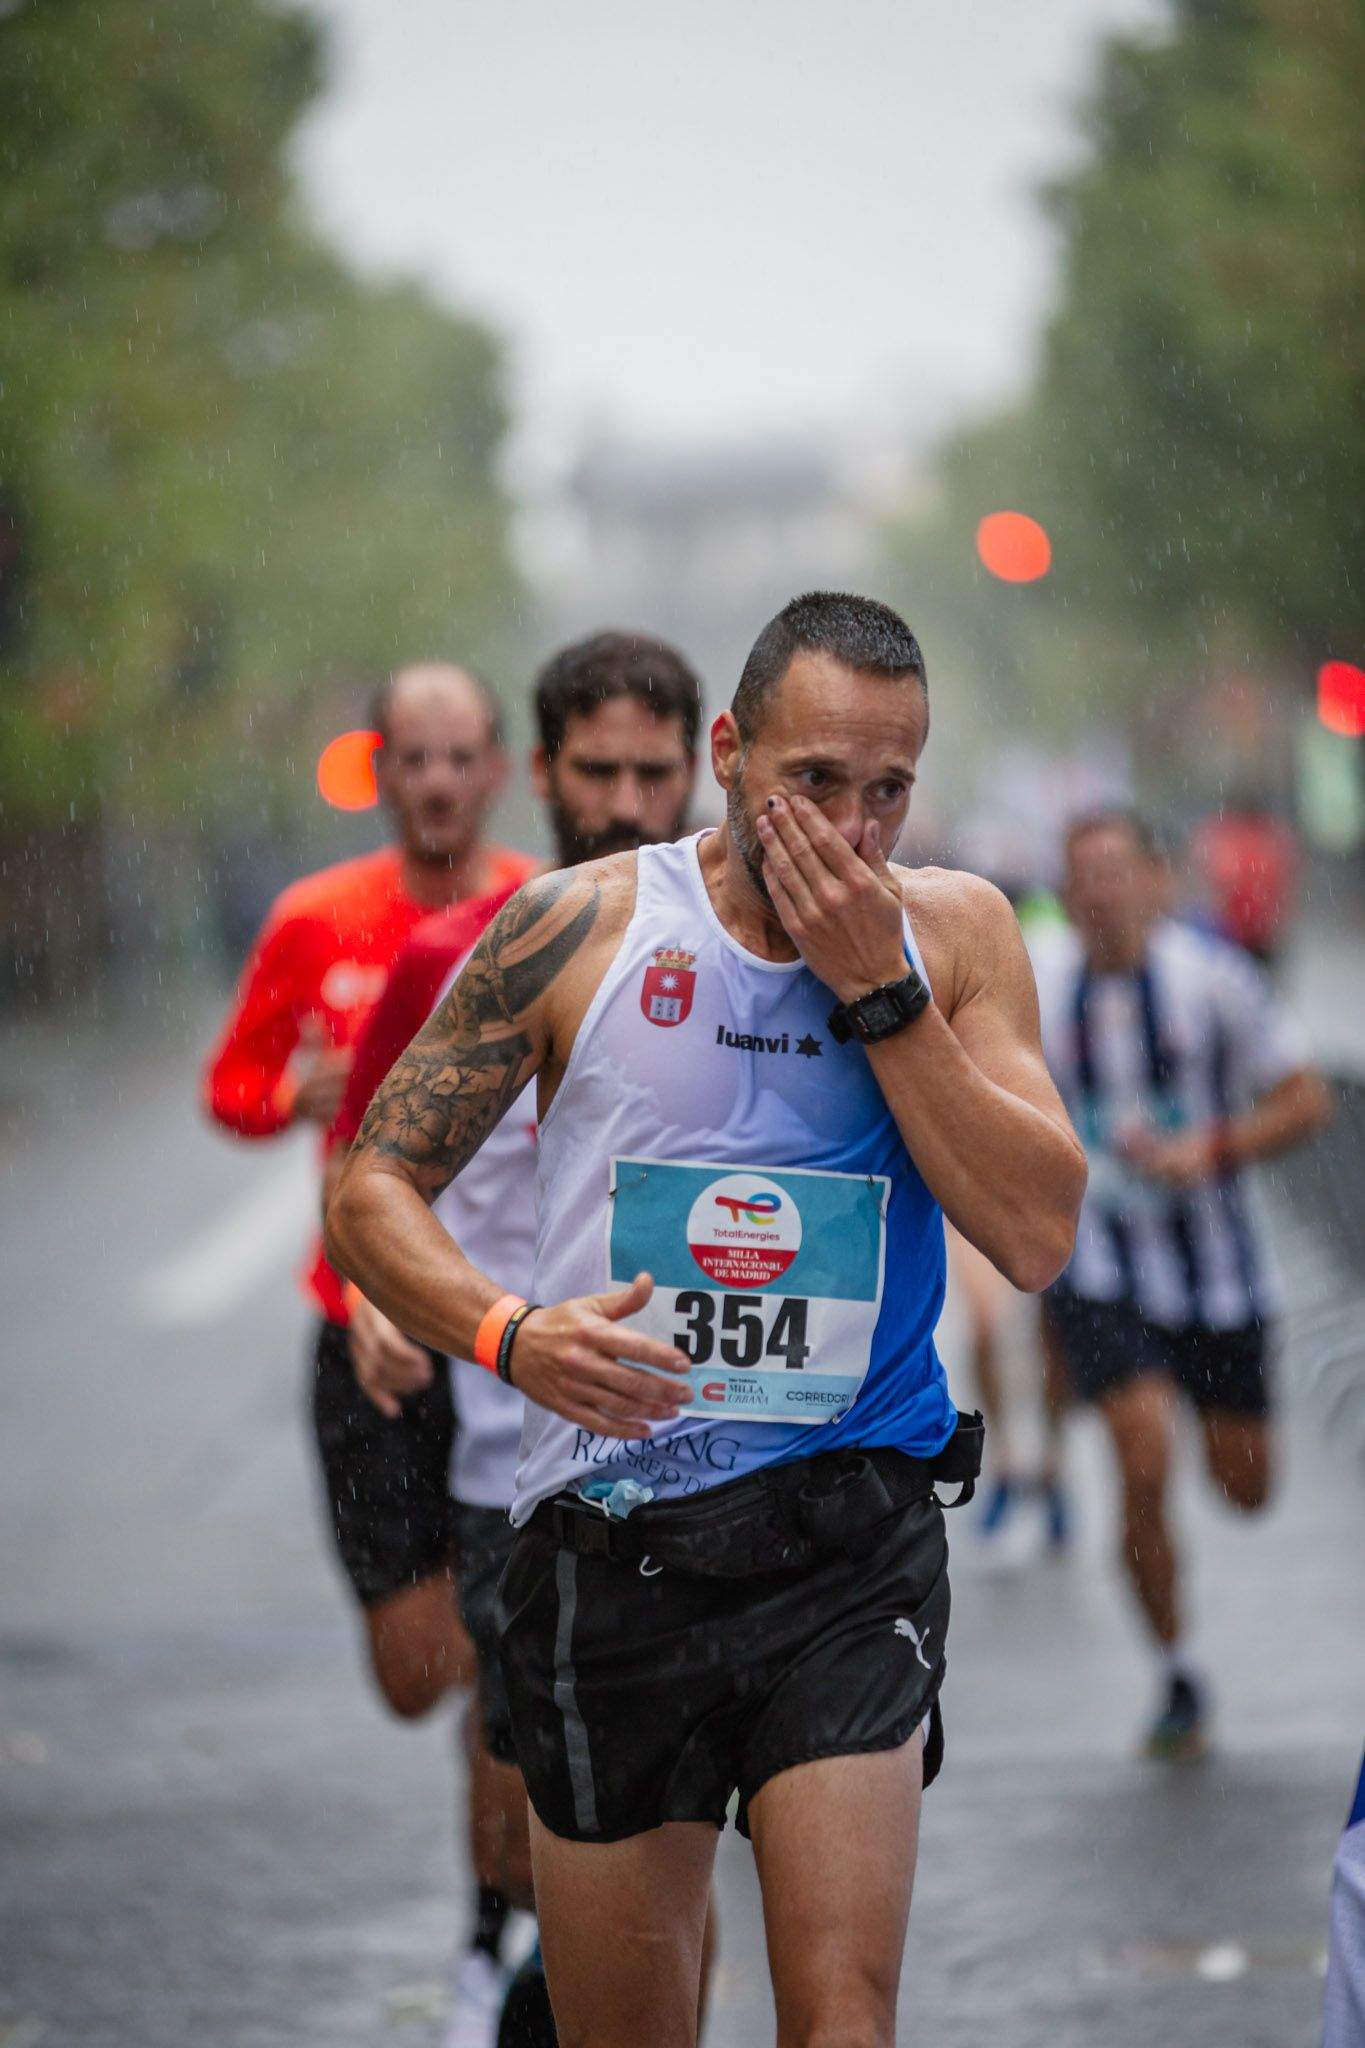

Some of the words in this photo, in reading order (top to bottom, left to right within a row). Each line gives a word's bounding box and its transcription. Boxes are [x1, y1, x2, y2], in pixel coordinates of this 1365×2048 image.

[715, 1025, 790, 1054] luanvi
[713, 1228, 781, 1242] TotalEnergies
[727, 1249, 760, 1260] MILLA
[702, 1257, 784, 1272] INTERNACIONAL
[714, 1269, 730, 1279] DE
[731, 1270, 771, 1281] MADRID
[673, 1290, 811, 1370] 354
[729, 1384, 764, 1395] MILLA
